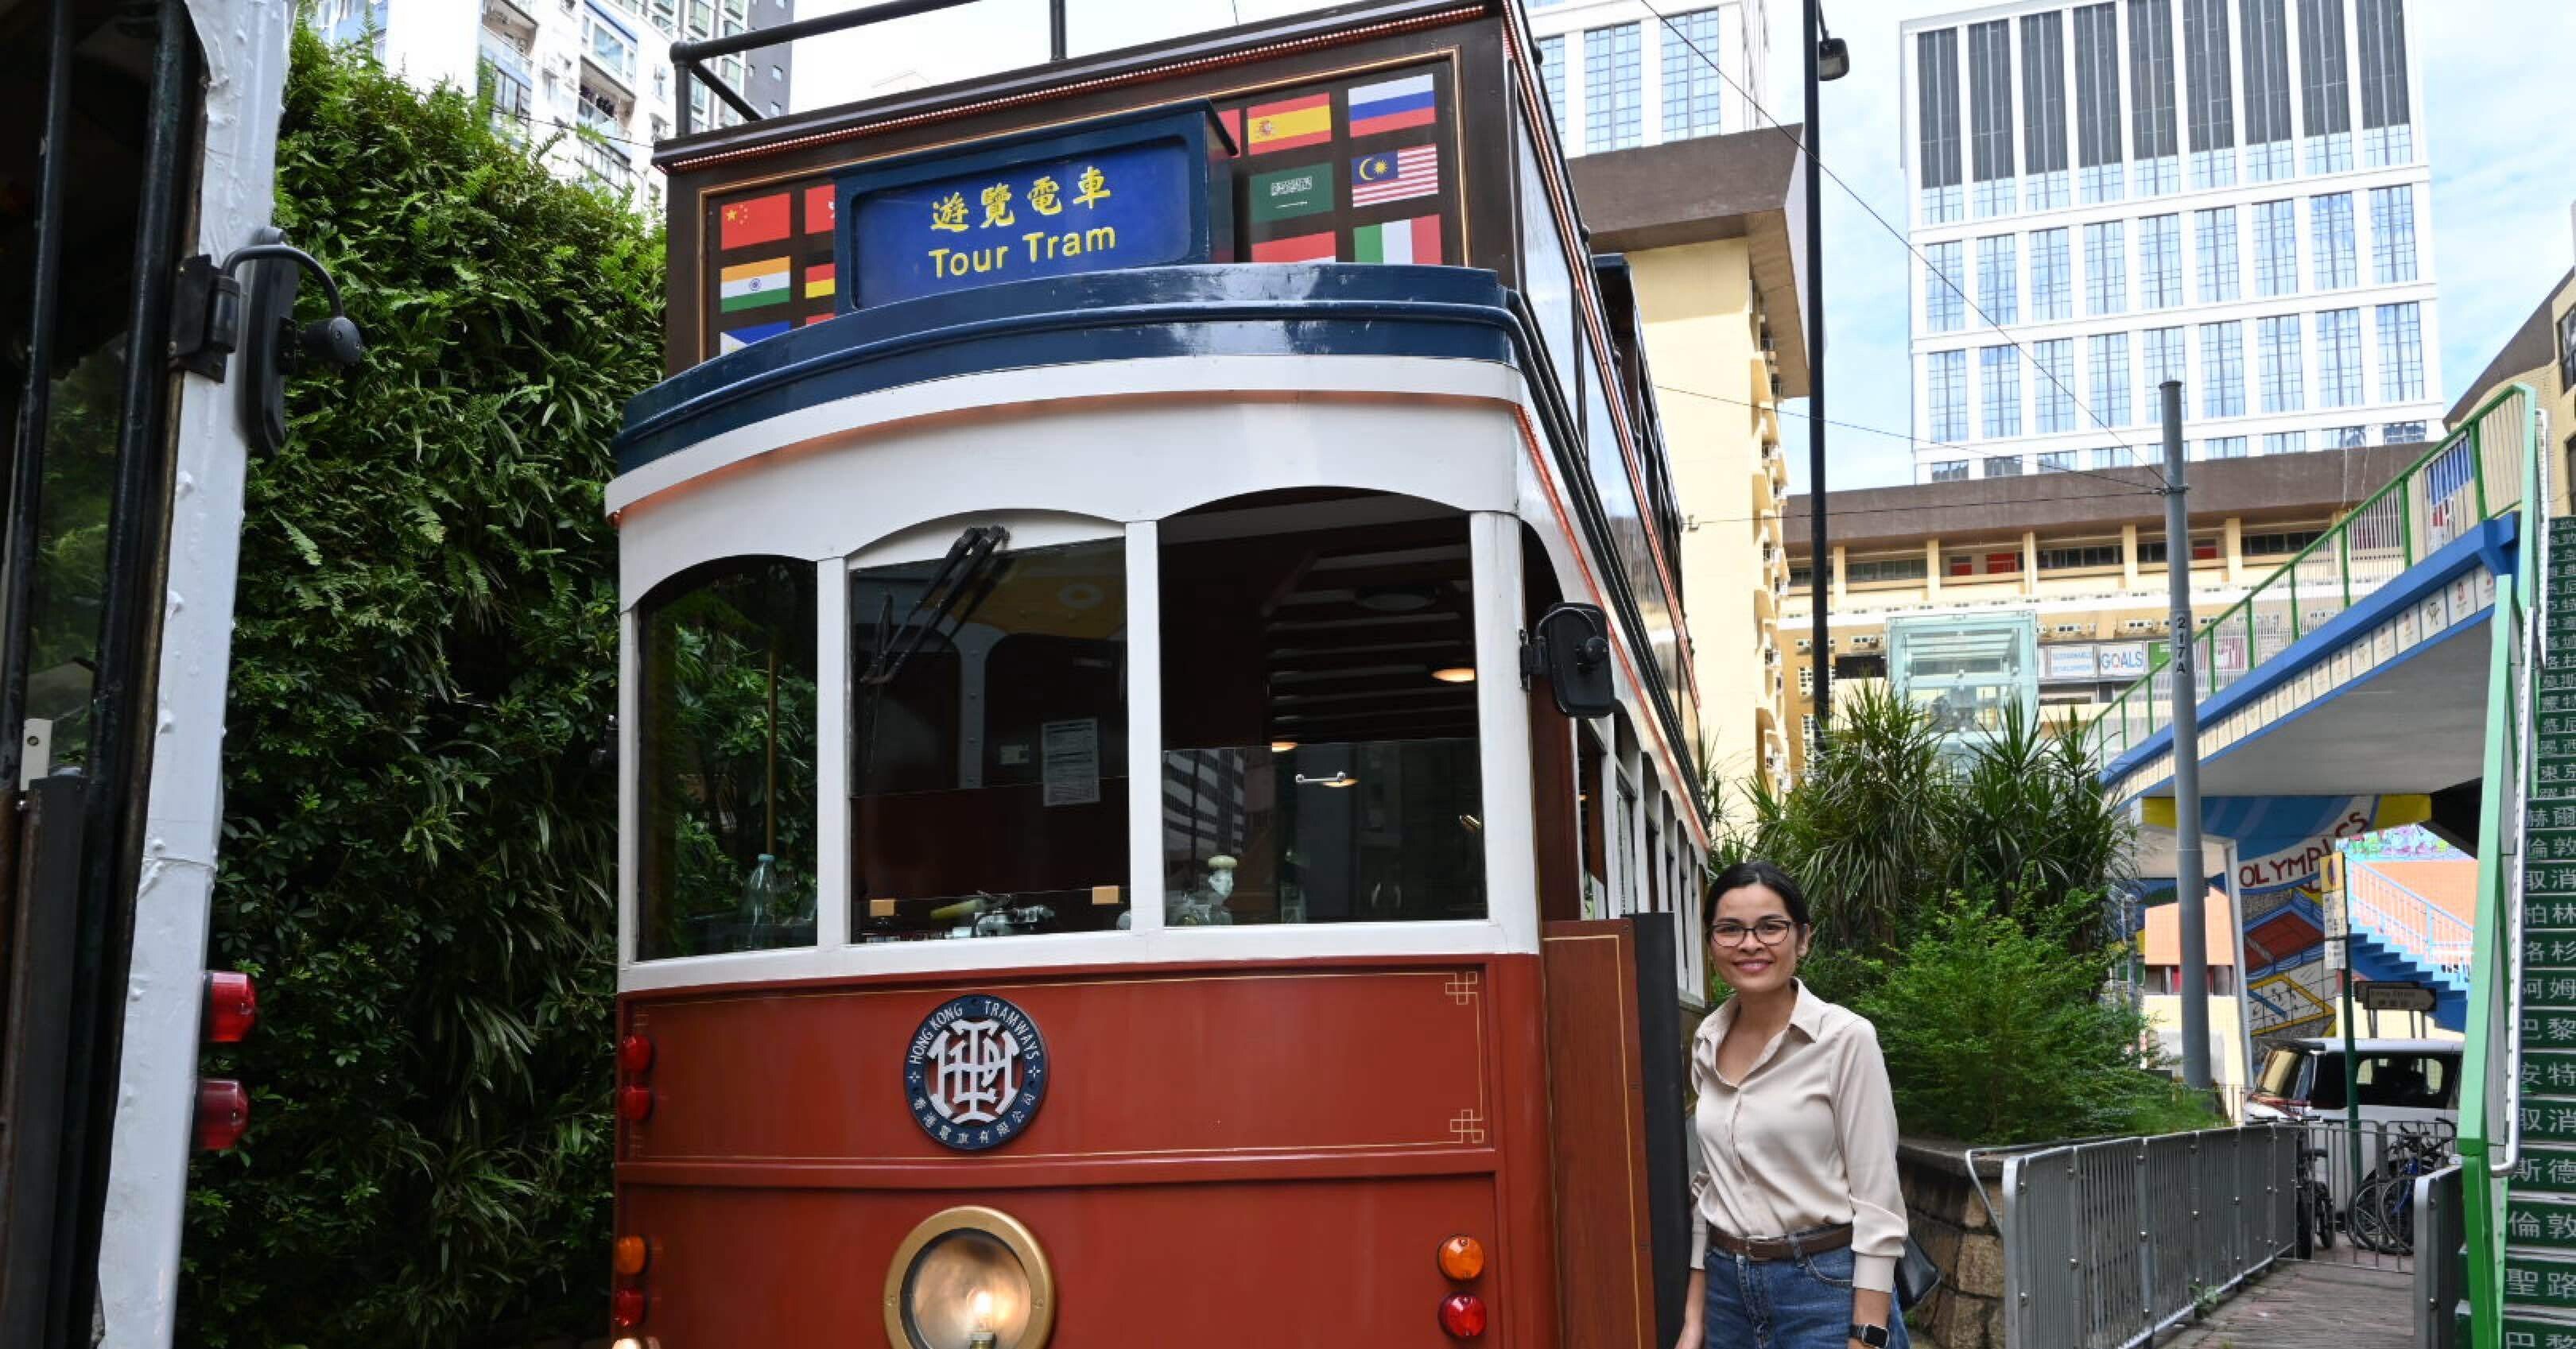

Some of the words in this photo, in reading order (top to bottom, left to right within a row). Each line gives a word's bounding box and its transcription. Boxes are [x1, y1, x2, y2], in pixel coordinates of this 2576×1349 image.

[929, 165, 1111, 232] 遊覽電車
[928, 244, 1009, 278] Tour
[1022, 226, 1116, 263] Tram
[2177, 616, 2186, 674] 217A
[2102, 651, 2143, 669] GOALS
[2539, 762, 2576, 784] 東京
[2524, 902, 2576, 925] 柏林
[910, 1028, 933, 1064] HONG
[929, 1002, 963, 1030] KONG
[984, 1000, 1041, 1060] TRAMWAYS
[2520, 1107, 2576, 1132] 取消
[2512, 1157, 2576, 1183] 斯德
[2508, 1211, 2576, 1239] 倫敦
[2506, 1269, 2576, 1298] 聖路
